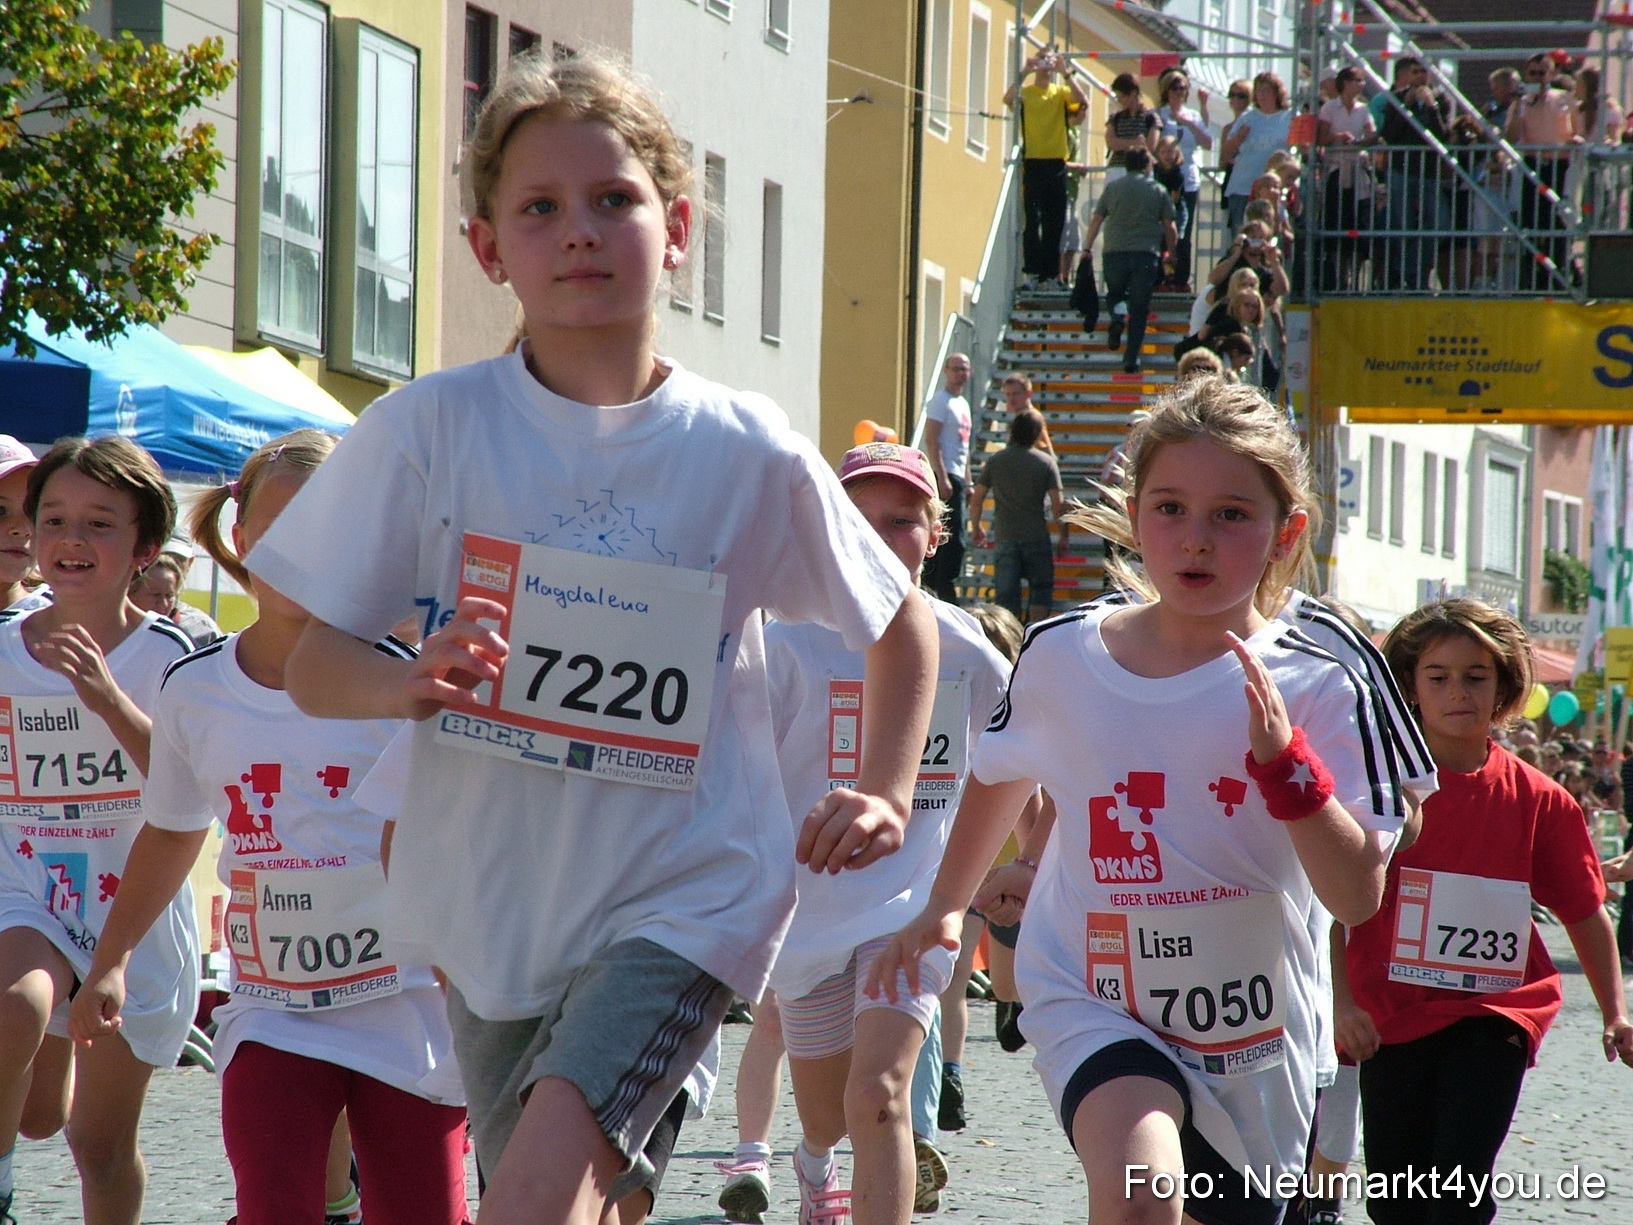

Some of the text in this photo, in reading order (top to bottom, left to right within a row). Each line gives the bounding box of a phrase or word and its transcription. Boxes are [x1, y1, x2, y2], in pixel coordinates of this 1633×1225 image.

[1363, 356, 1543, 375] Neumarkter Stadtlauf
[525, 574, 649, 614] Magdalena
[1530, 619, 1586, 635] sutor
[525, 644, 689, 726] 7220
[18, 707, 80, 732] Isabell
[440, 713, 538, 751] BOCK
[0, 745, 8, 763] 3
[597, 746, 696, 776] PFLEIDERER
[25, 748, 128, 788] 7154
[595, 766, 694, 788] AKTIENGESELLSCHAFT
[80, 798, 142, 814] PFLEIDERER
[38, 827, 85, 838] EINZELNE
[86, 827, 116, 839] ZÄHLT
[228, 831, 280, 851] DKMS
[1093, 855, 1158, 880] DKMS
[262, 884, 313, 912] Anna
[1146, 889, 1209, 906] EINZELNE
[230, 923, 250, 945] K3
[1138, 927, 1193, 959] Lisa
[1437, 924, 1519, 963] 7233
[269, 927, 383, 973] 7002
[1100, 942, 1124, 951] BÜGL
[1391, 964, 1446, 981] BOCK
[1477, 974, 1522, 988] PFLEIDERER
[235, 983, 292, 1003] BOCK
[332, 974, 399, 999] PFLEIDERER
[1096, 977, 1121, 1001] K3
[1149, 974, 1274, 1033] 7050
[1226, 1037, 1284, 1068] PFLEIDERER
